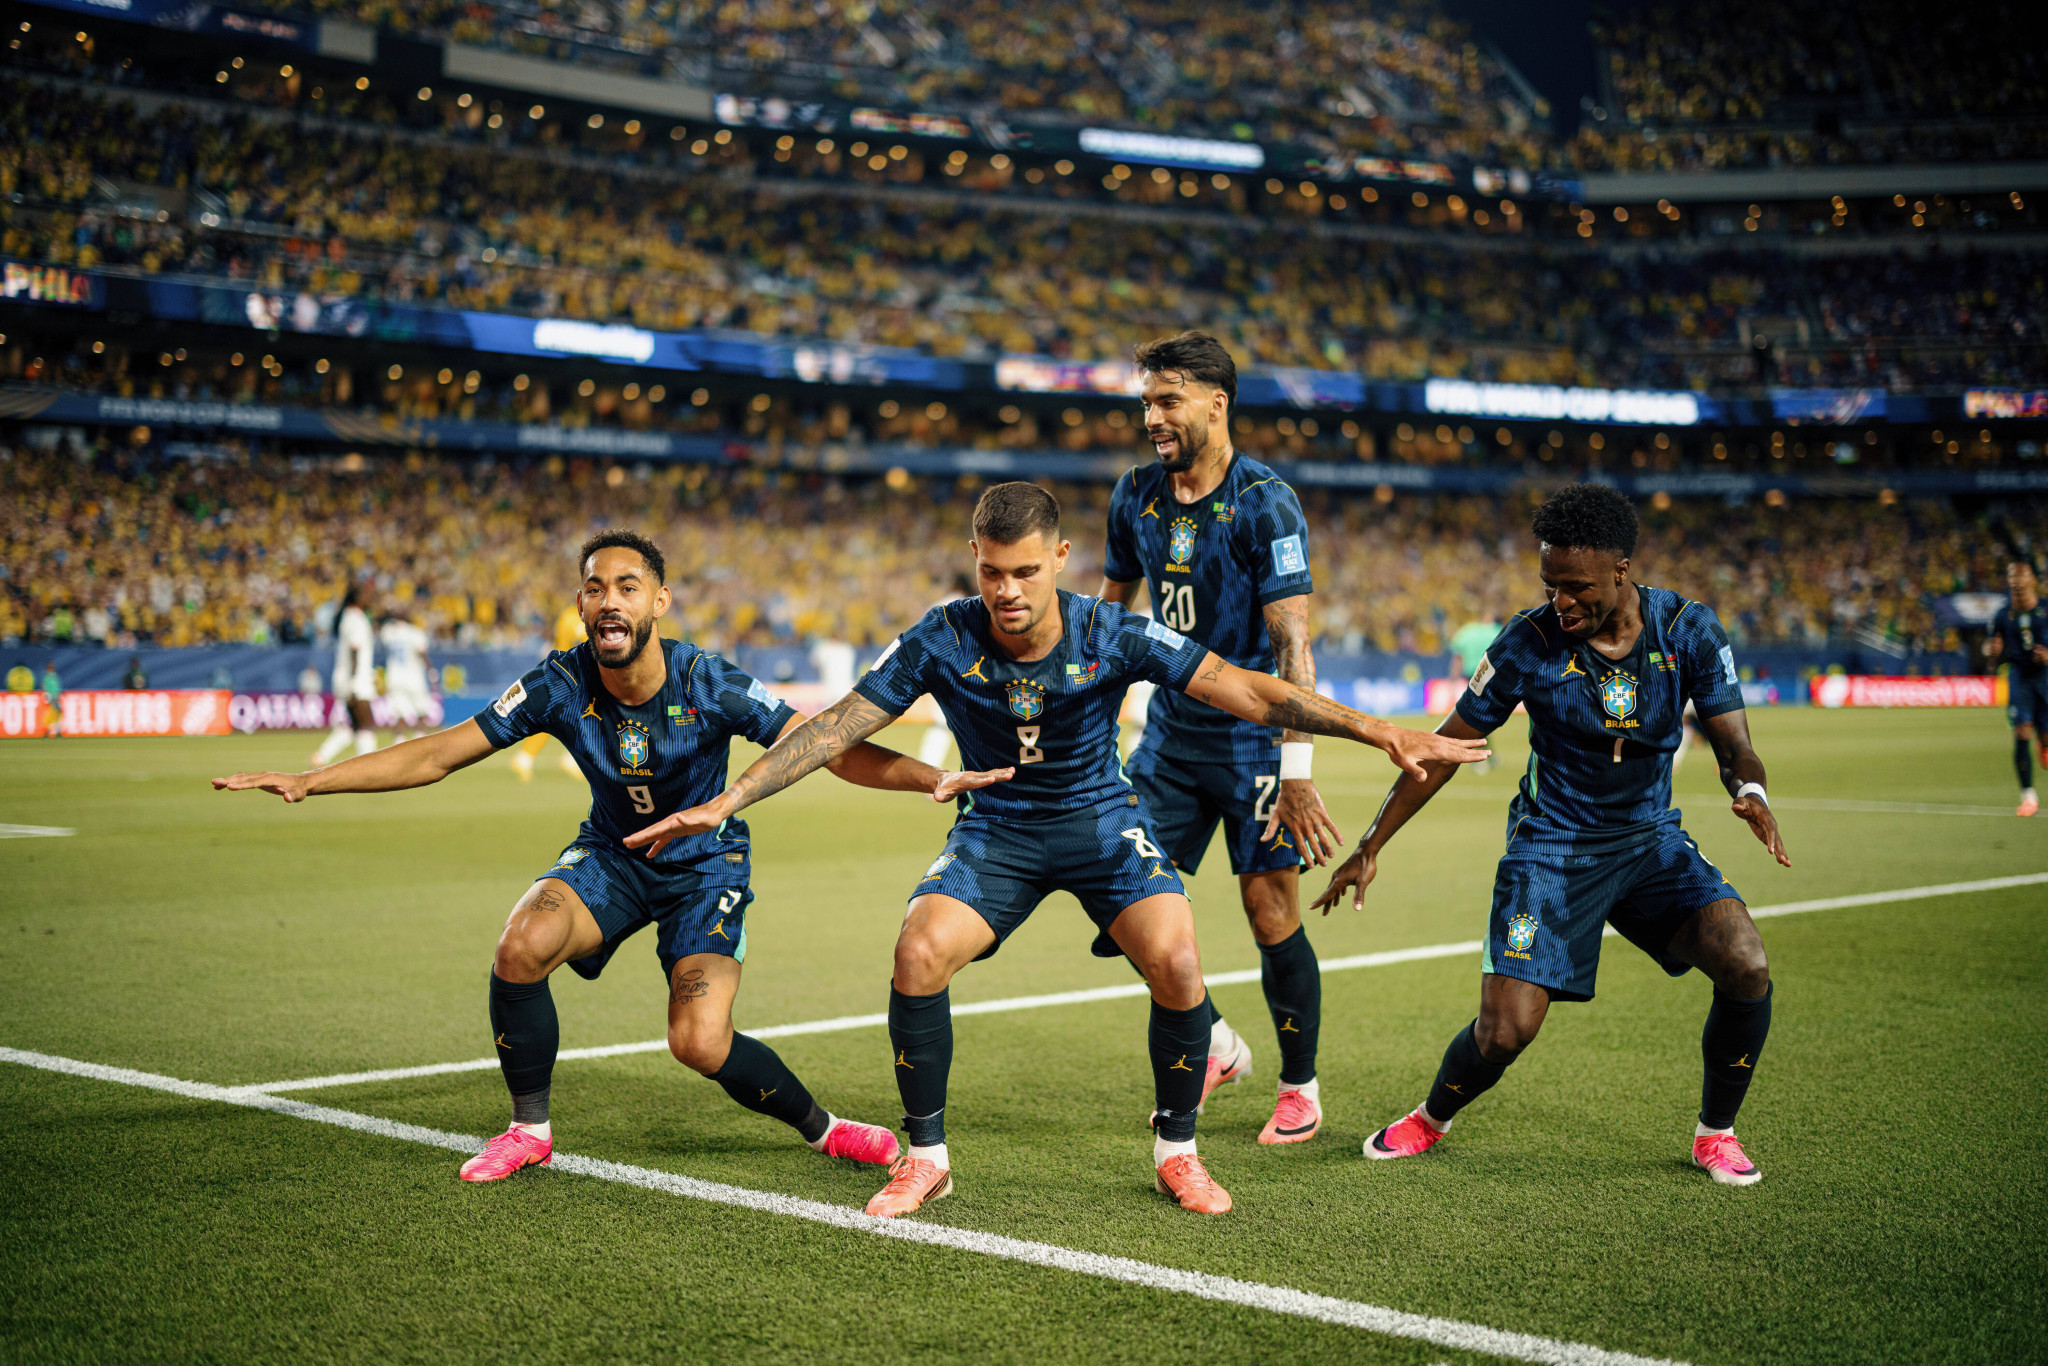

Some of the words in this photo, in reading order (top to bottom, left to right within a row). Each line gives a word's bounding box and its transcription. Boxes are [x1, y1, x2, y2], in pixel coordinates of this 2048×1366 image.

[1165, 563, 1191, 573] BRASIL
[1161, 580, 1196, 632] 20
[0, 694, 39, 735] OT
[61, 692, 171, 735] ELIVERS
[228, 694, 325, 734] QATAR
[1605, 719, 1640, 728] BRASIL
[1016, 725, 1044, 764] 8
[620, 767, 654, 776] BRASIL
[626, 785, 655, 815] 9
[1255, 775, 1281, 821] 2
[1120, 827, 1163, 858] 8
[1504, 950, 1532, 960] BRASIL
